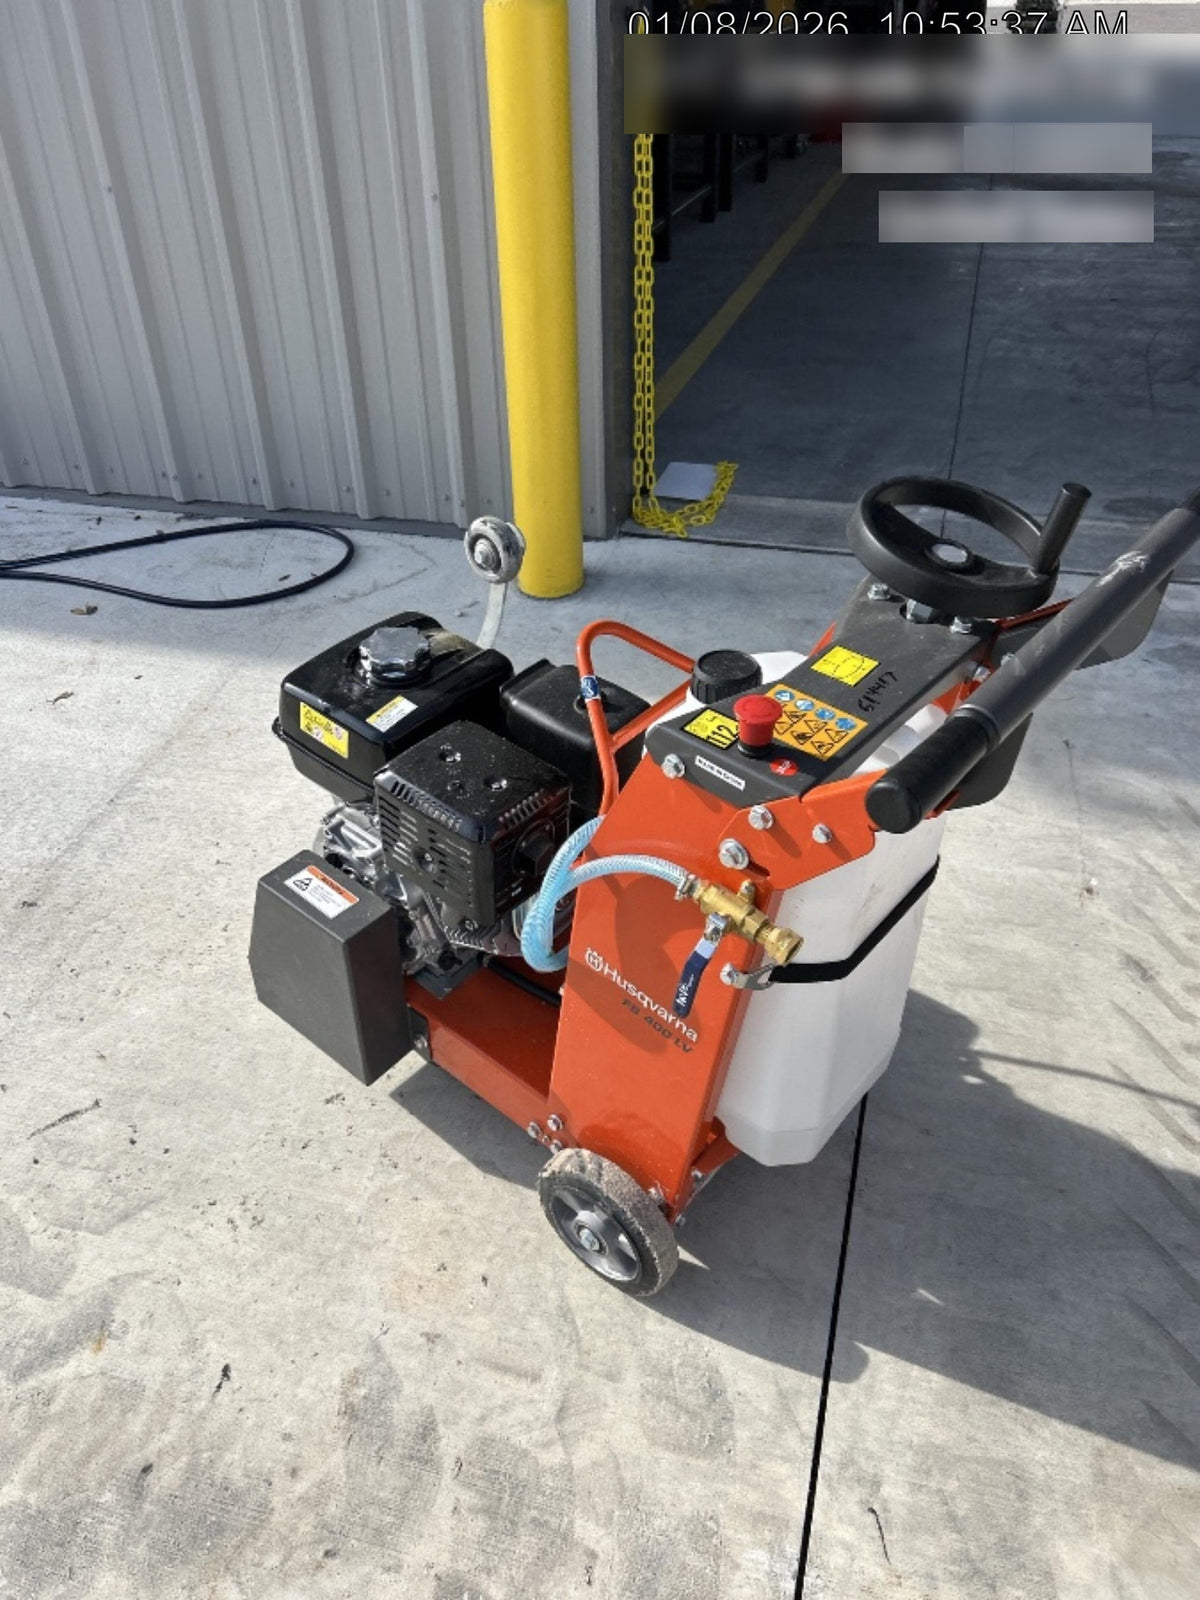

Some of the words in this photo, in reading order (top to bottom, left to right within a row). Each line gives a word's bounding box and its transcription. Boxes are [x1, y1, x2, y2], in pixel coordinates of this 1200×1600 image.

[603, 962, 698, 1042] Husqvarna
[644, 1015, 672, 1039] 400
[674, 1037, 693, 1053] LV
